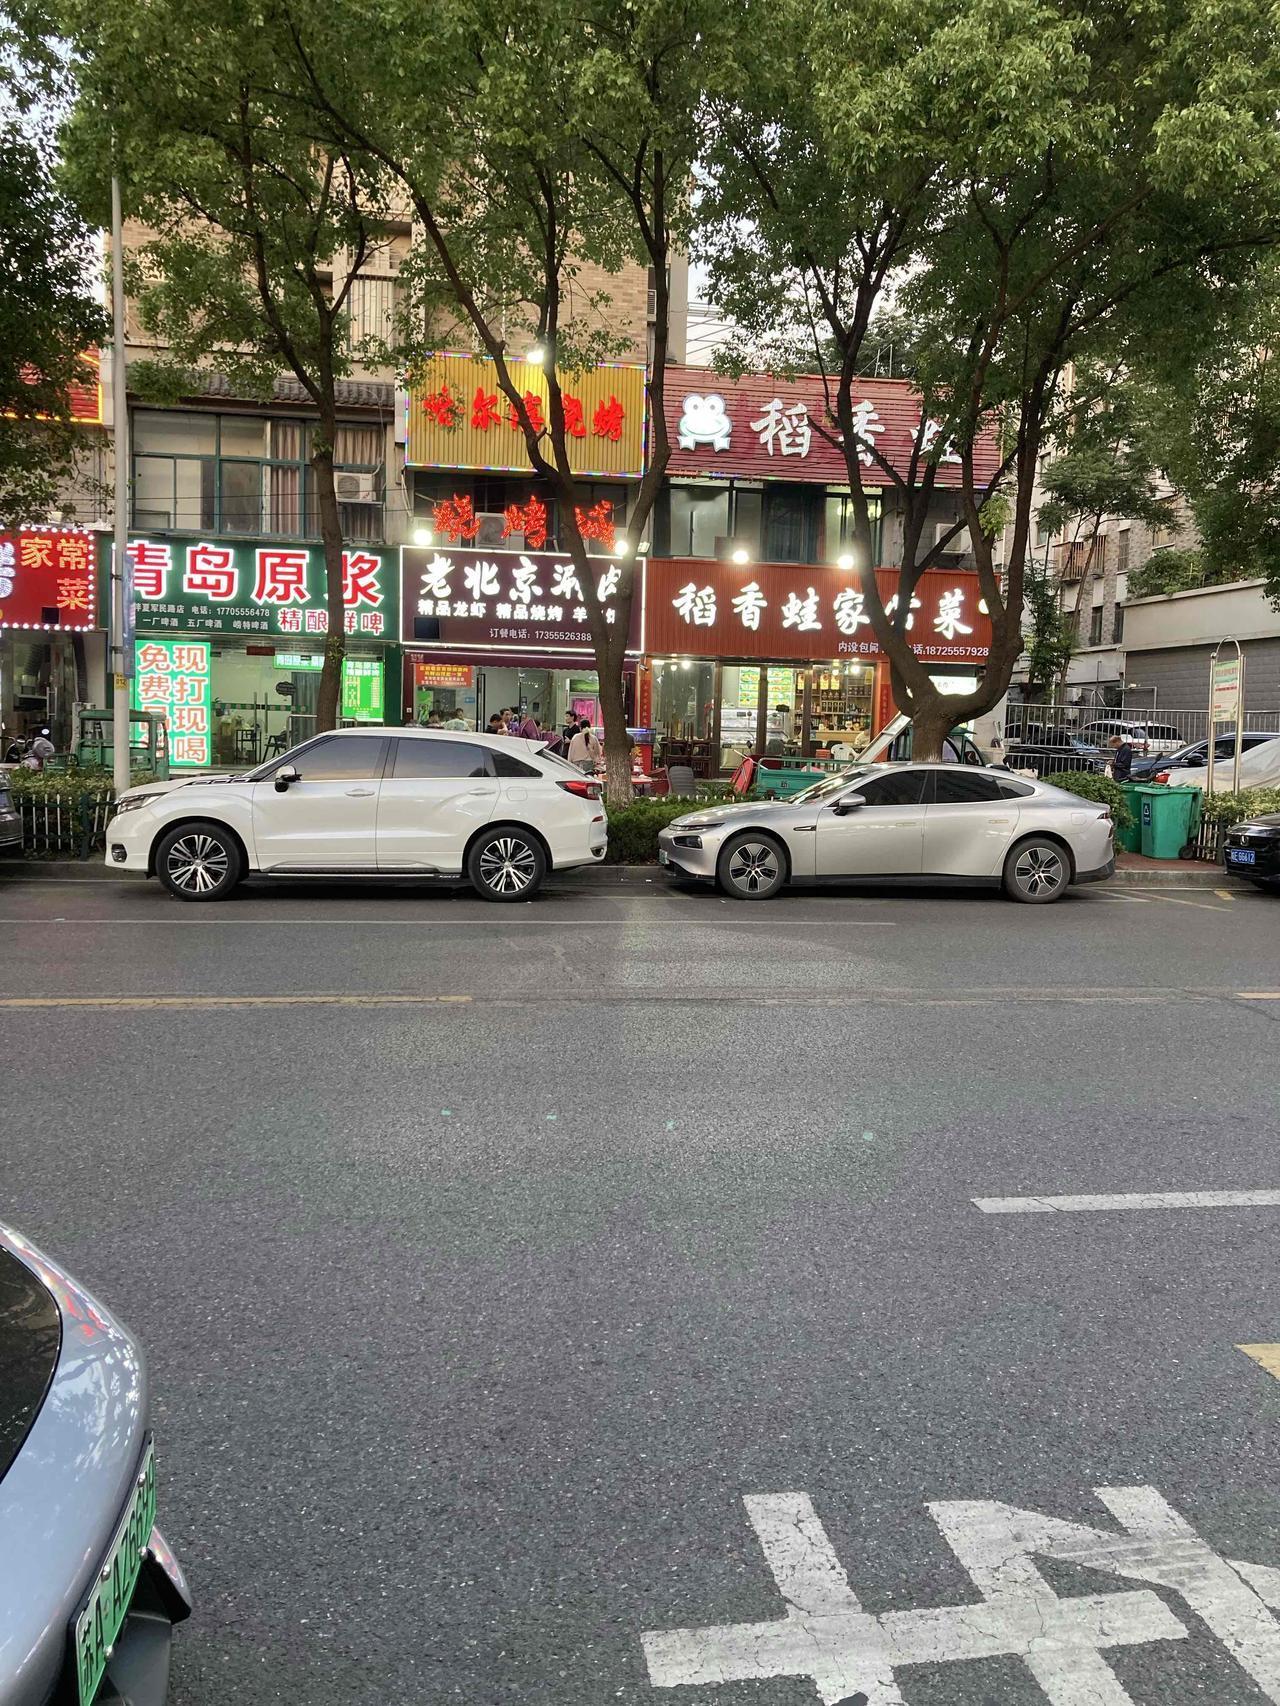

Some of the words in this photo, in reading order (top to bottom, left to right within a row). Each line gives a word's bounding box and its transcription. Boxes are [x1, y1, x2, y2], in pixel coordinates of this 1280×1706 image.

[125, 541, 384, 604] 青岛原浆
[417, 599, 487, 618] 精品龙虾
[496, 602, 563, 622] 精品烧烤
